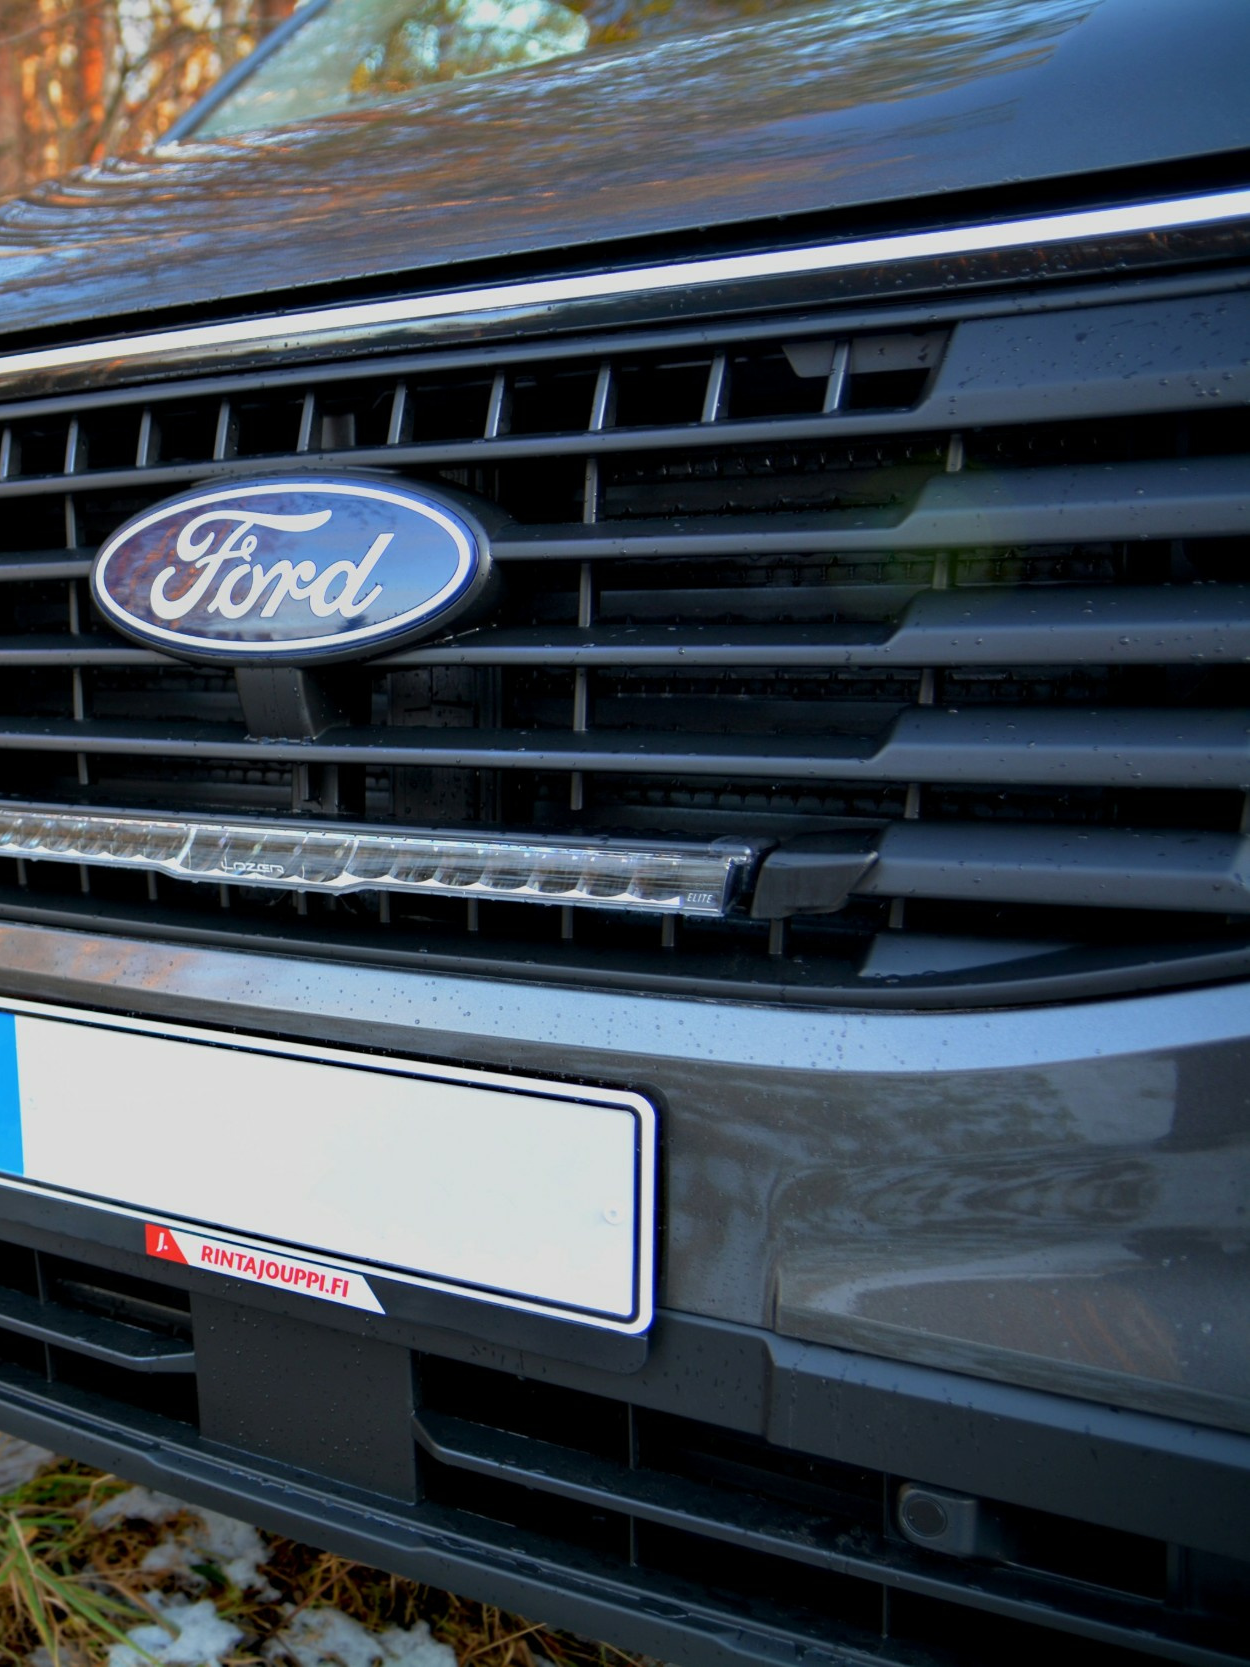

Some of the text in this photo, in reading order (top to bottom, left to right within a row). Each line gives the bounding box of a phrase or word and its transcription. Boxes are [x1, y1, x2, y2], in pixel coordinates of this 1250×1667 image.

[150, 509, 395, 619] Ford
[687, 892, 714, 904] ELITE
[200, 1244, 350, 1298] RINTAJOUPPI.FI
